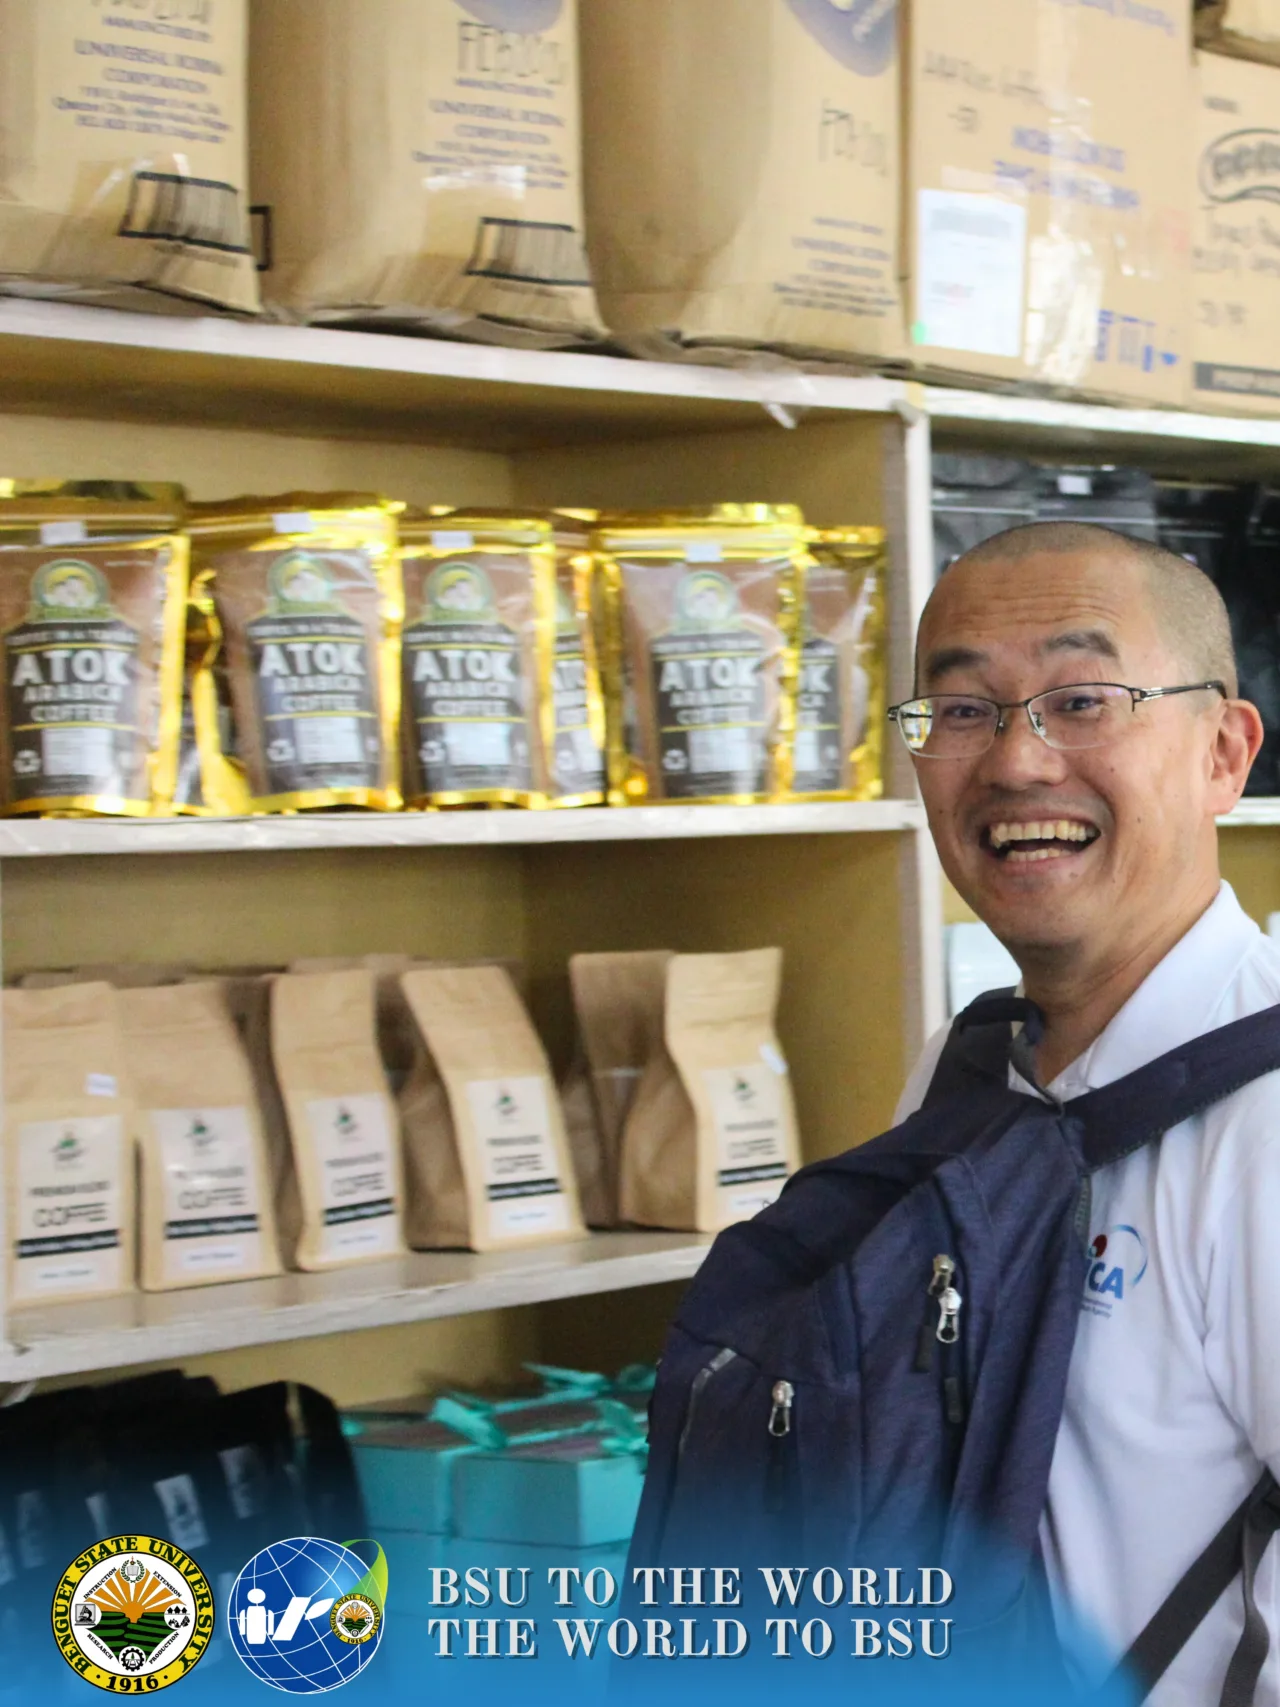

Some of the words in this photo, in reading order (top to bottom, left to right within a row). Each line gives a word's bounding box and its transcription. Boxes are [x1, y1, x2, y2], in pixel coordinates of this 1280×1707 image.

[12, 649, 131, 687] ATOK
[260, 643, 366, 677] ATOK
[413, 650, 516, 682] ATOK
[659, 658, 760, 692] ATOK
[1089, 1262, 1123, 1300] CA
